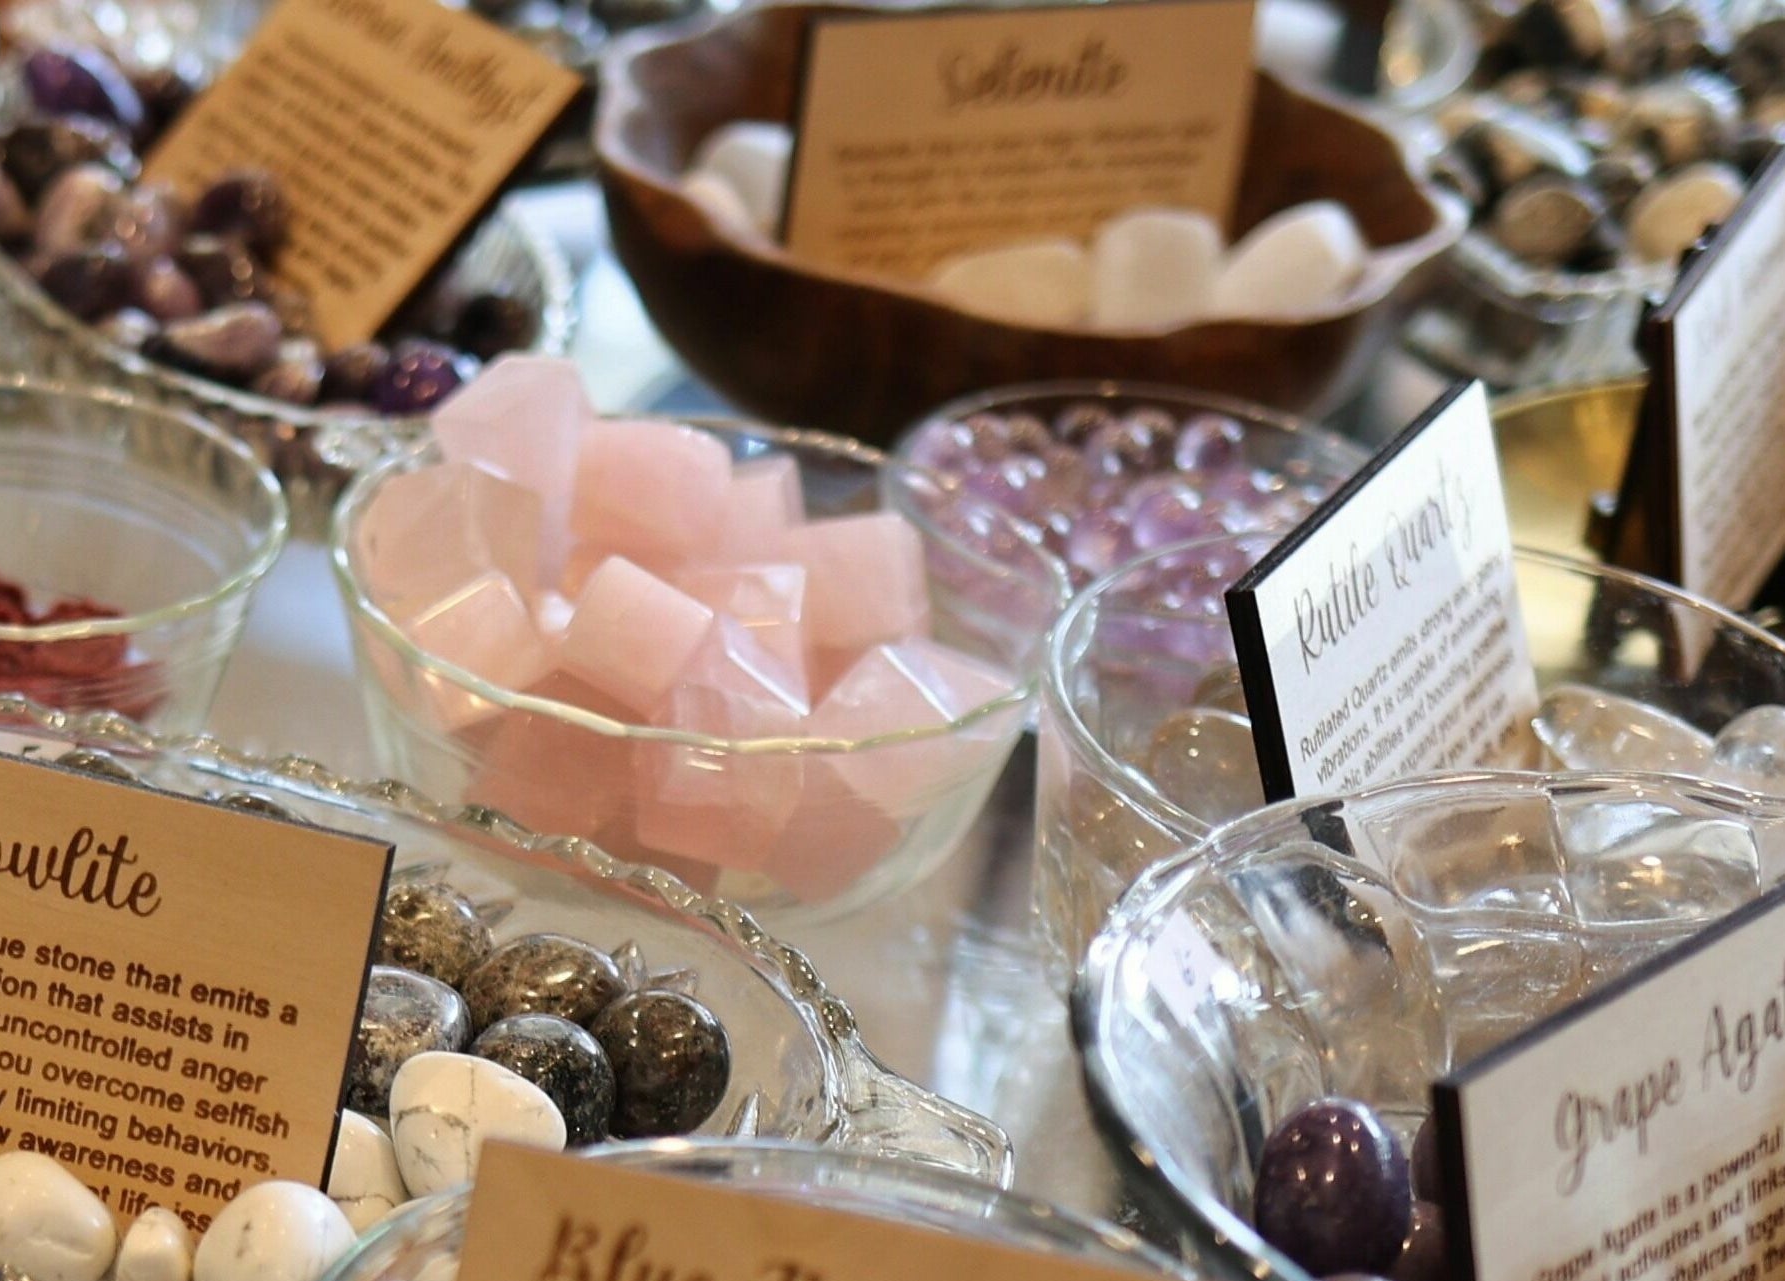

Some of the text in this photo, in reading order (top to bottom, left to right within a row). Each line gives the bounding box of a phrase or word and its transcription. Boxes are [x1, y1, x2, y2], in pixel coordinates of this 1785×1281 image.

[1294, 541, 1379, 675] Rutile
[1299, 697, 1351, 763] Rutilated
[34, 944, 115, 981] stone
[125, 961, 181, 997] that
[190, 982, 270, 1018] emits
[279, 1004, 298, 1025] a
[48, 981, 103, 1017] that
[111, 1002, 213, 1043] assists
[222, 1022, 249, 1052] in
[41, 1061, 184, 1112] overcome
[194, 1098, 289, 1138] selfish
[180, 1057, 267, 1093] anger
[15, 1085, 118, 1141] limiting
[127, 1114, 276, 1175] behaviors.
[17, 1131, 174, 1186] awareness
[184, 1173, 241, 1202] and
